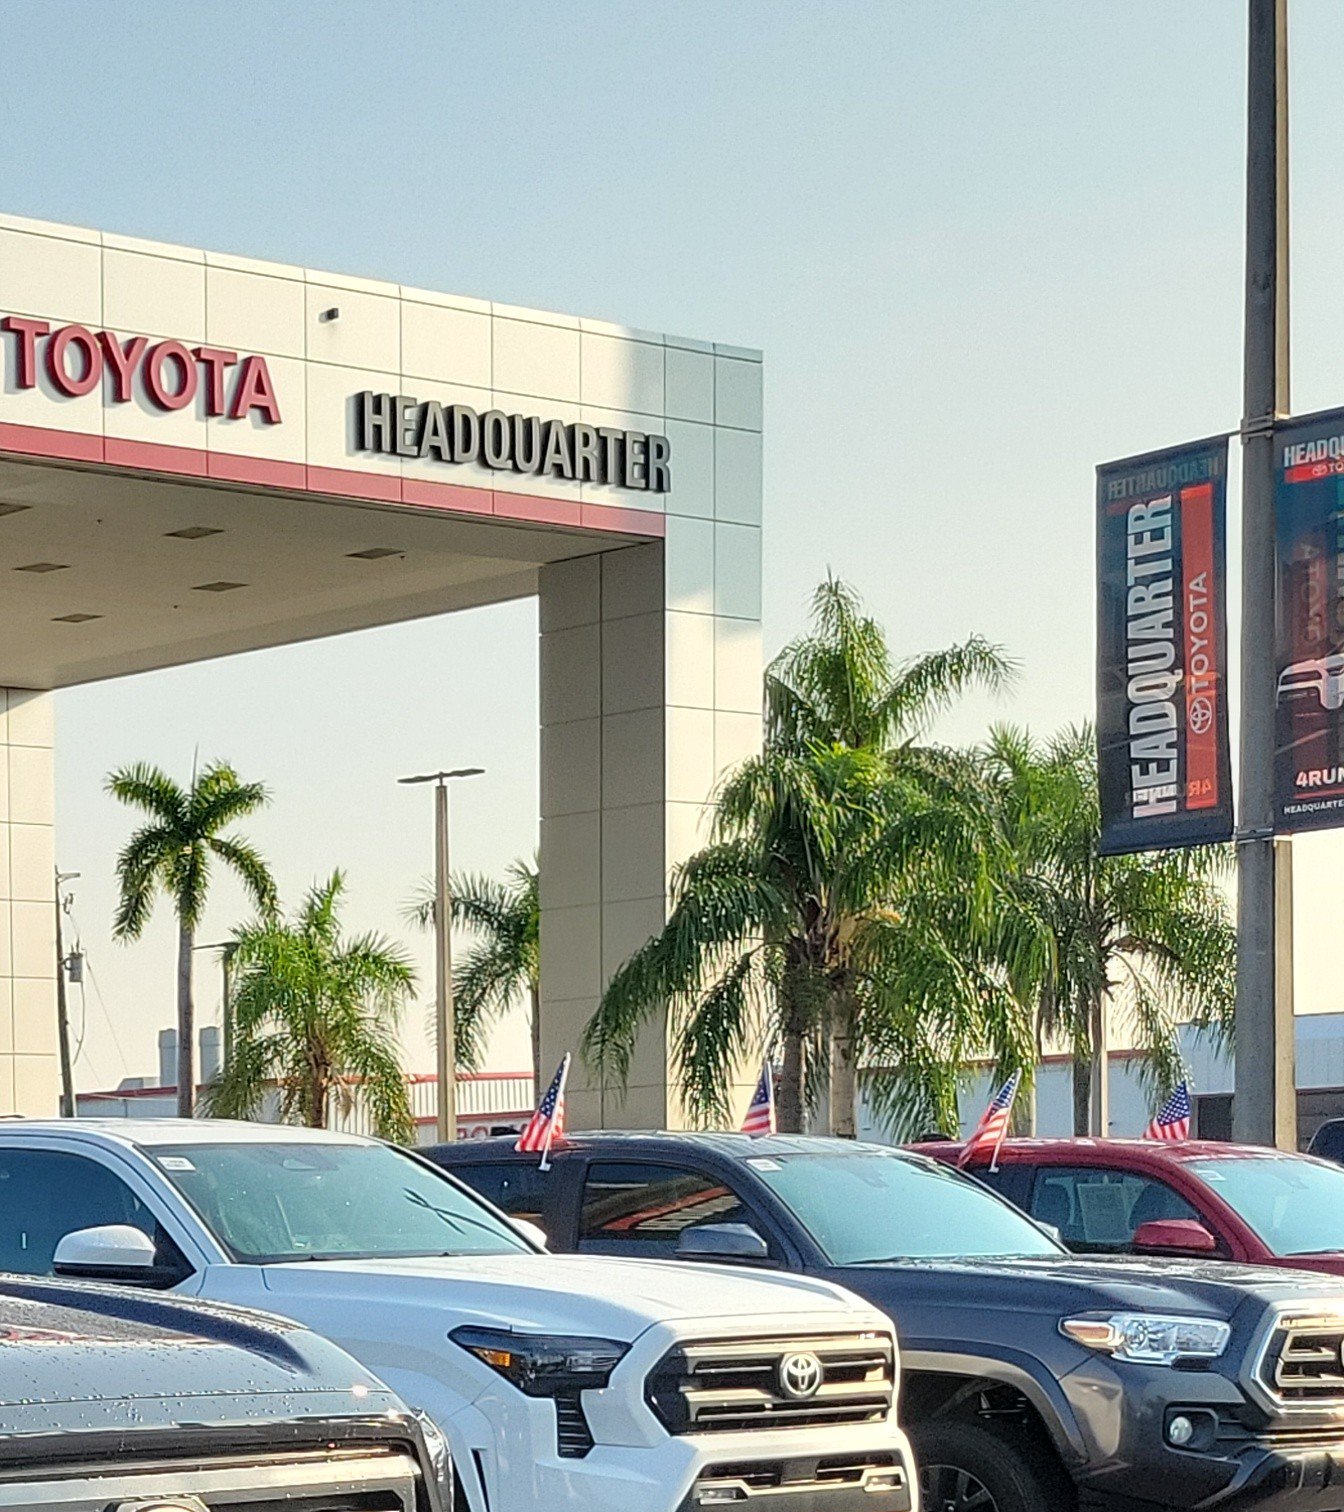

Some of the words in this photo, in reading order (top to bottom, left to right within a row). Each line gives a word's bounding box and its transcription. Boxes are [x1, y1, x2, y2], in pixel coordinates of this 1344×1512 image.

[0, 315, 283, 425] TOYOTA
[358, 390, 672, 493] HEADQUARTER
[1284, 436, 1344, 467] HEADQ
[1126, 494, 1180, 818] HEADQUARTER
[1187, 570, 1212, 693] TOYOTA
